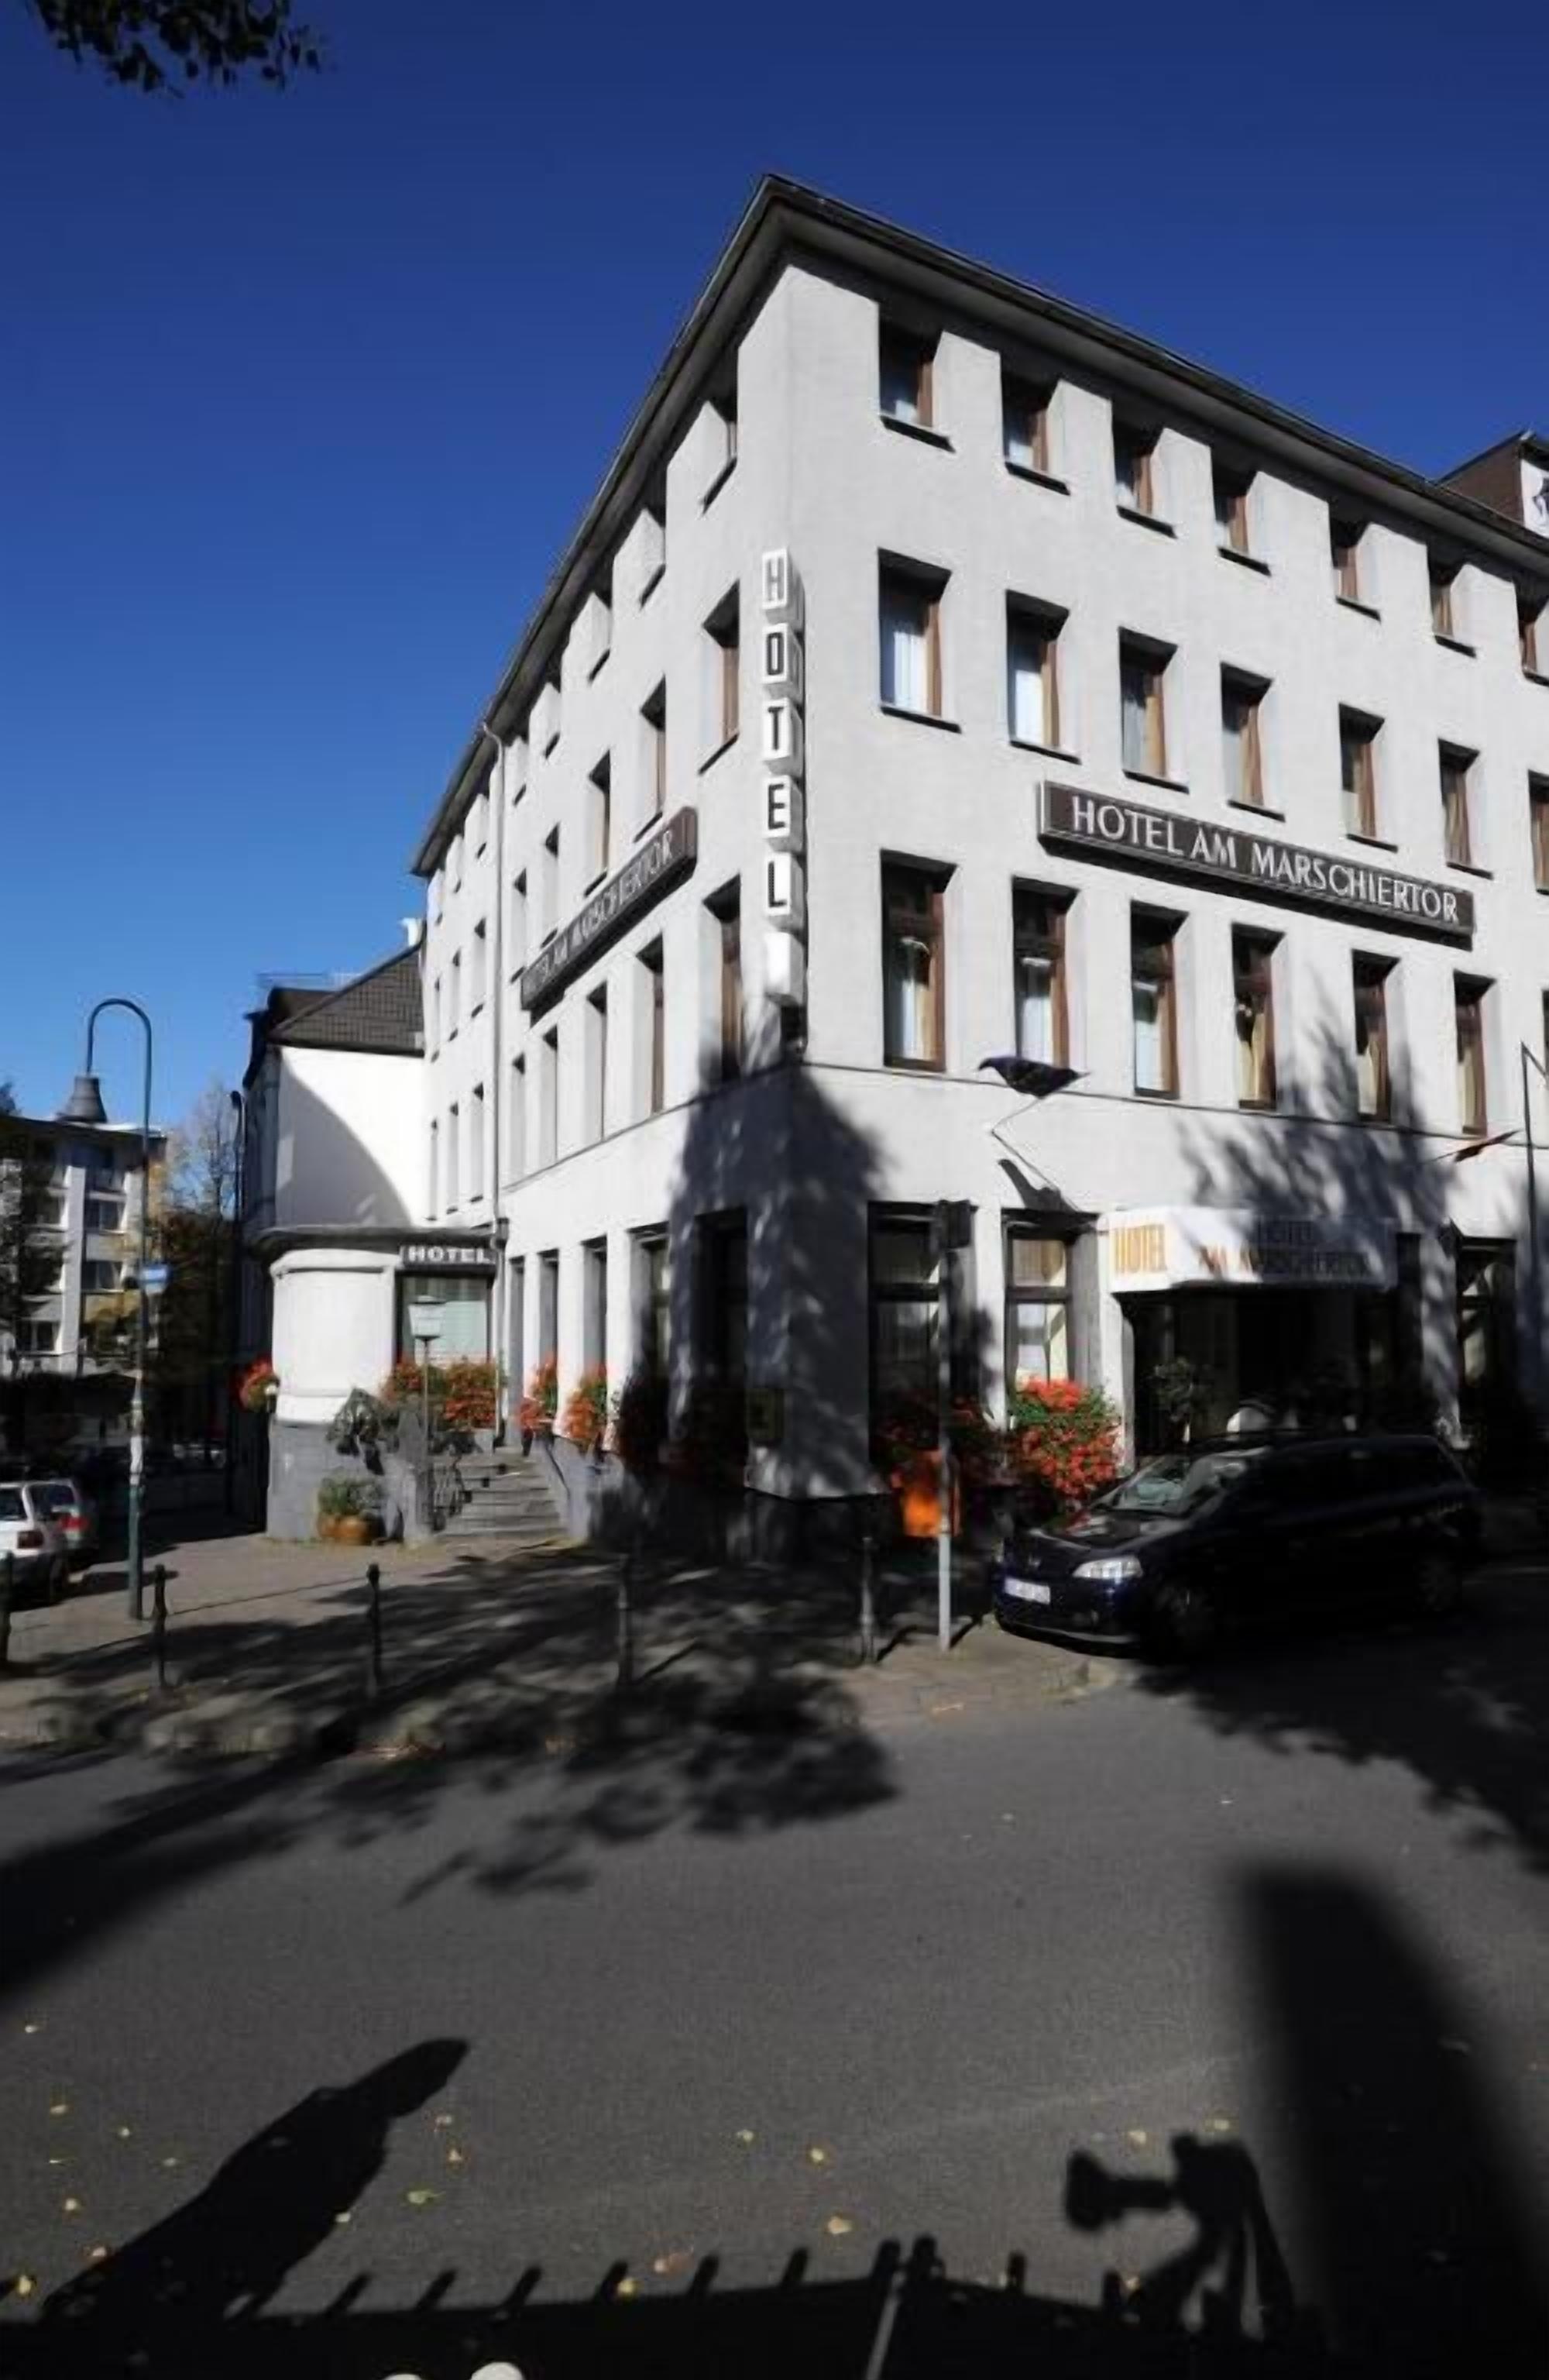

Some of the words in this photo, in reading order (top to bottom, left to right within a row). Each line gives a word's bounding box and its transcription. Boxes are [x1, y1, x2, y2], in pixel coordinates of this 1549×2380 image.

[765, 555, 788, 908] HOTEL
[1072, 795, 1183, 856] HOTEL
[1190, 822, 1236, 868] AM
[1250, 841, 1459, 924] MARSCHIERTOR
[407, 1246, 490, 1264] HOTEL
[1115, 1224, 1166, 1275] HOTEL
